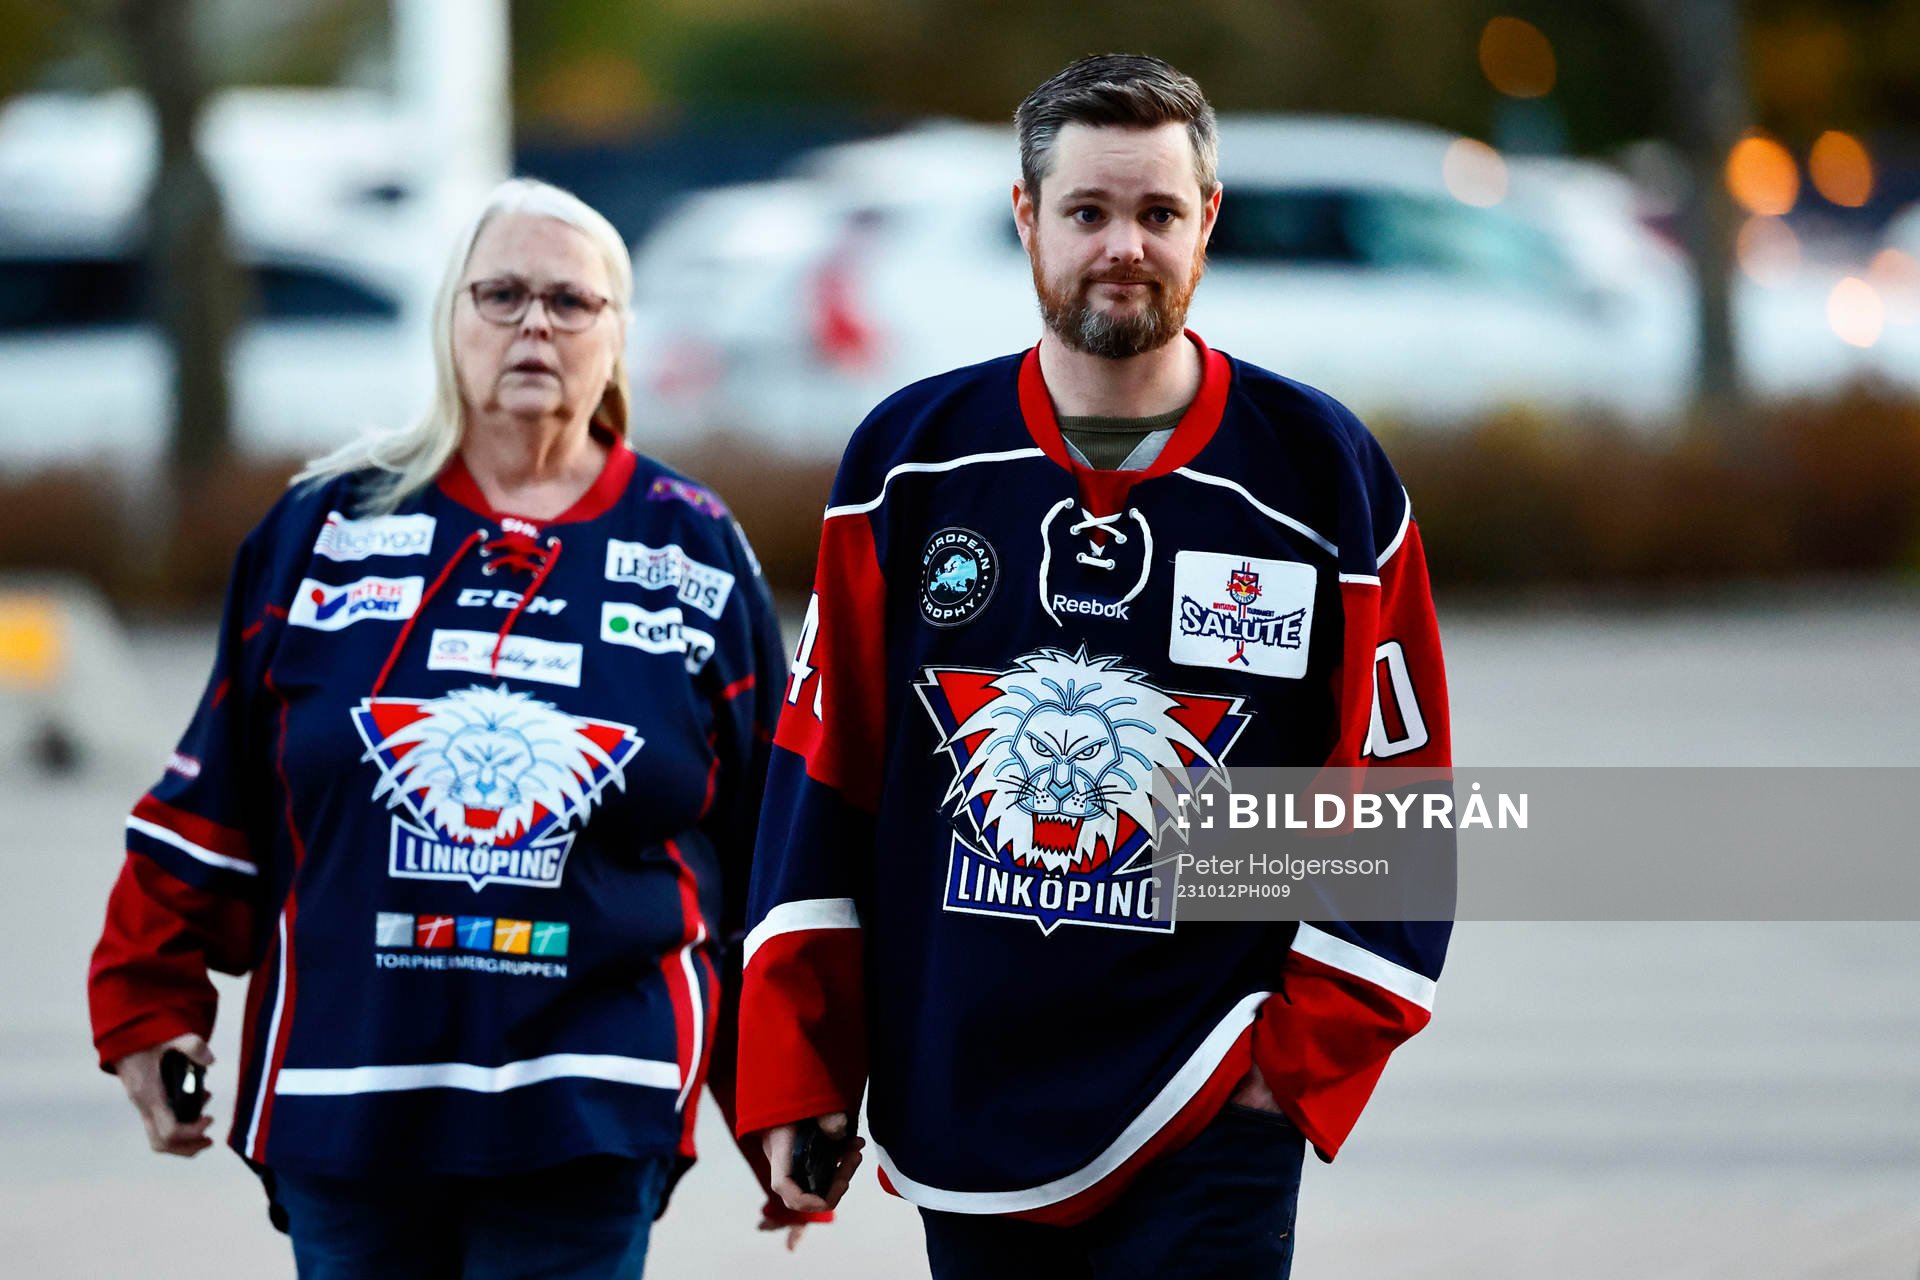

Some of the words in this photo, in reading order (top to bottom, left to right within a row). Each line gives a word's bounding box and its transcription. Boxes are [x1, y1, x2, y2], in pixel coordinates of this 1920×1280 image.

[923, 533, 991, 571] EUROPEAN
[457, 587, 567, 616] CCM
[922, 597, 975, 619] TROPHY
[1053, 594, 1129, 621] Reebok
[1182, 601, 1304, 647] SALUTE
[786, 590, 823, 724] 4
[405, 836, 561, 881] LINKÖPING
[957, 854, 1163, 920] LINKÖPING
